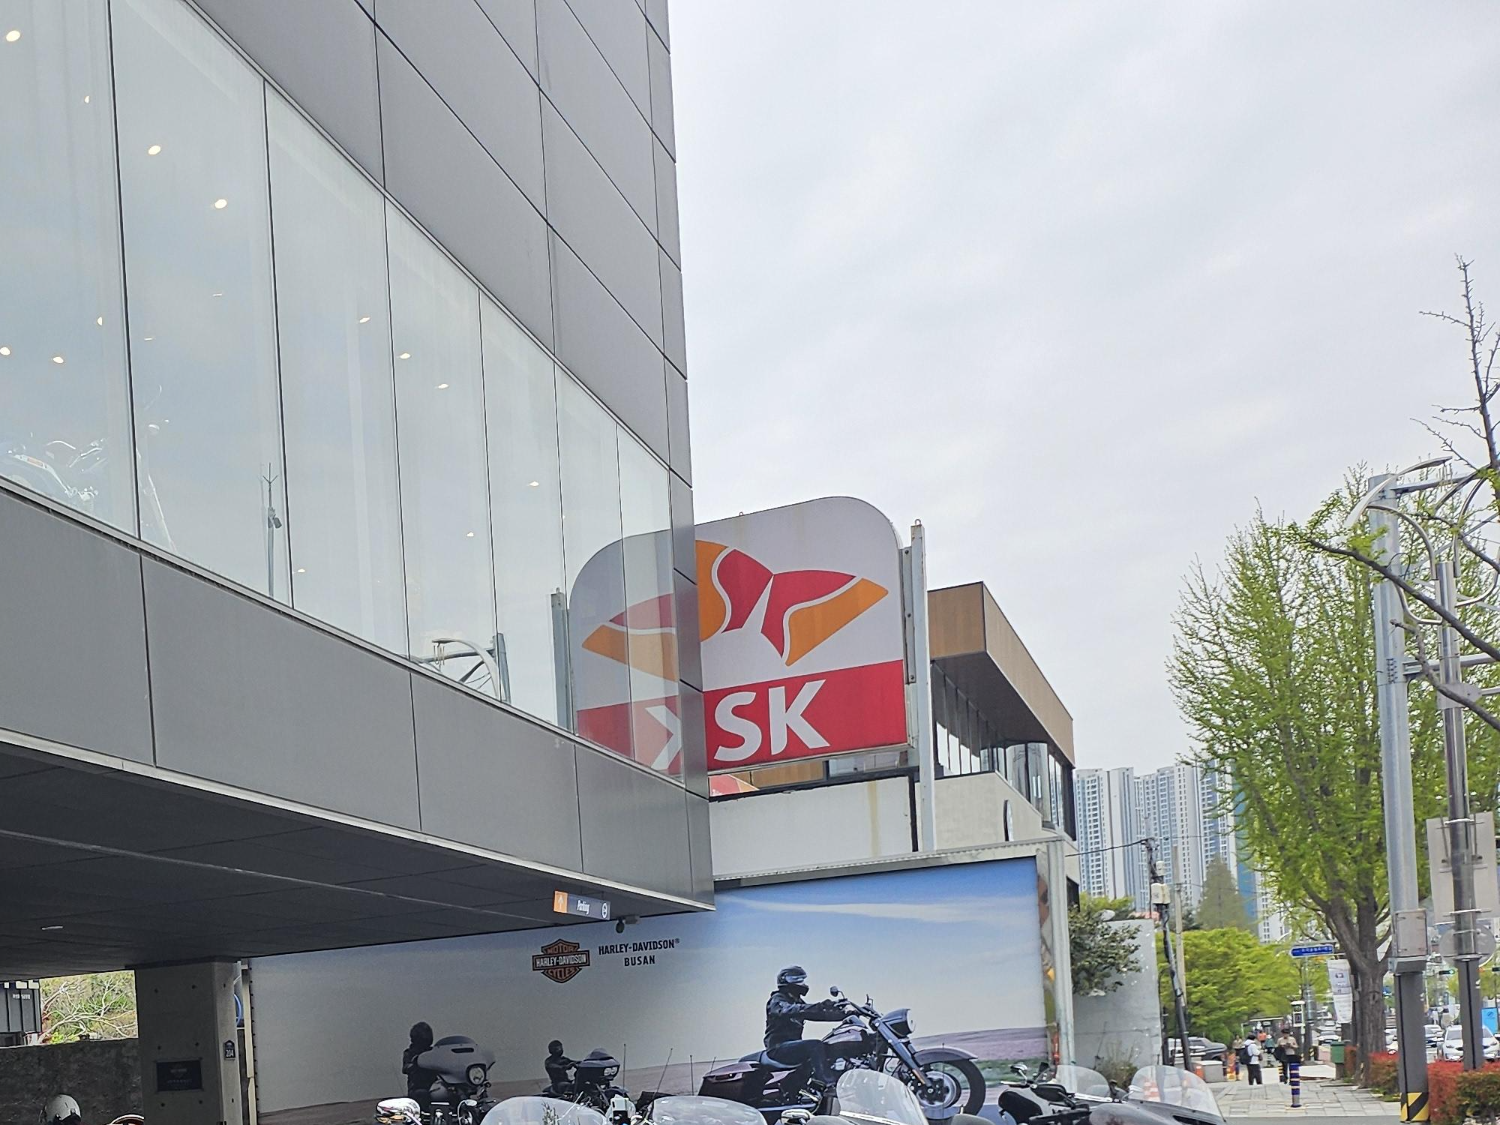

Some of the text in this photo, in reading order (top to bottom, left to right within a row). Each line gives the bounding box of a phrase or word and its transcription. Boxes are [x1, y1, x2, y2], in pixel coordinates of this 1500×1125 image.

[713, 679, 831, 762] SK
[536, 953, 587, 968] HARLEY-DAVIDSON
[623, 955, 656, 967] BUSAN
